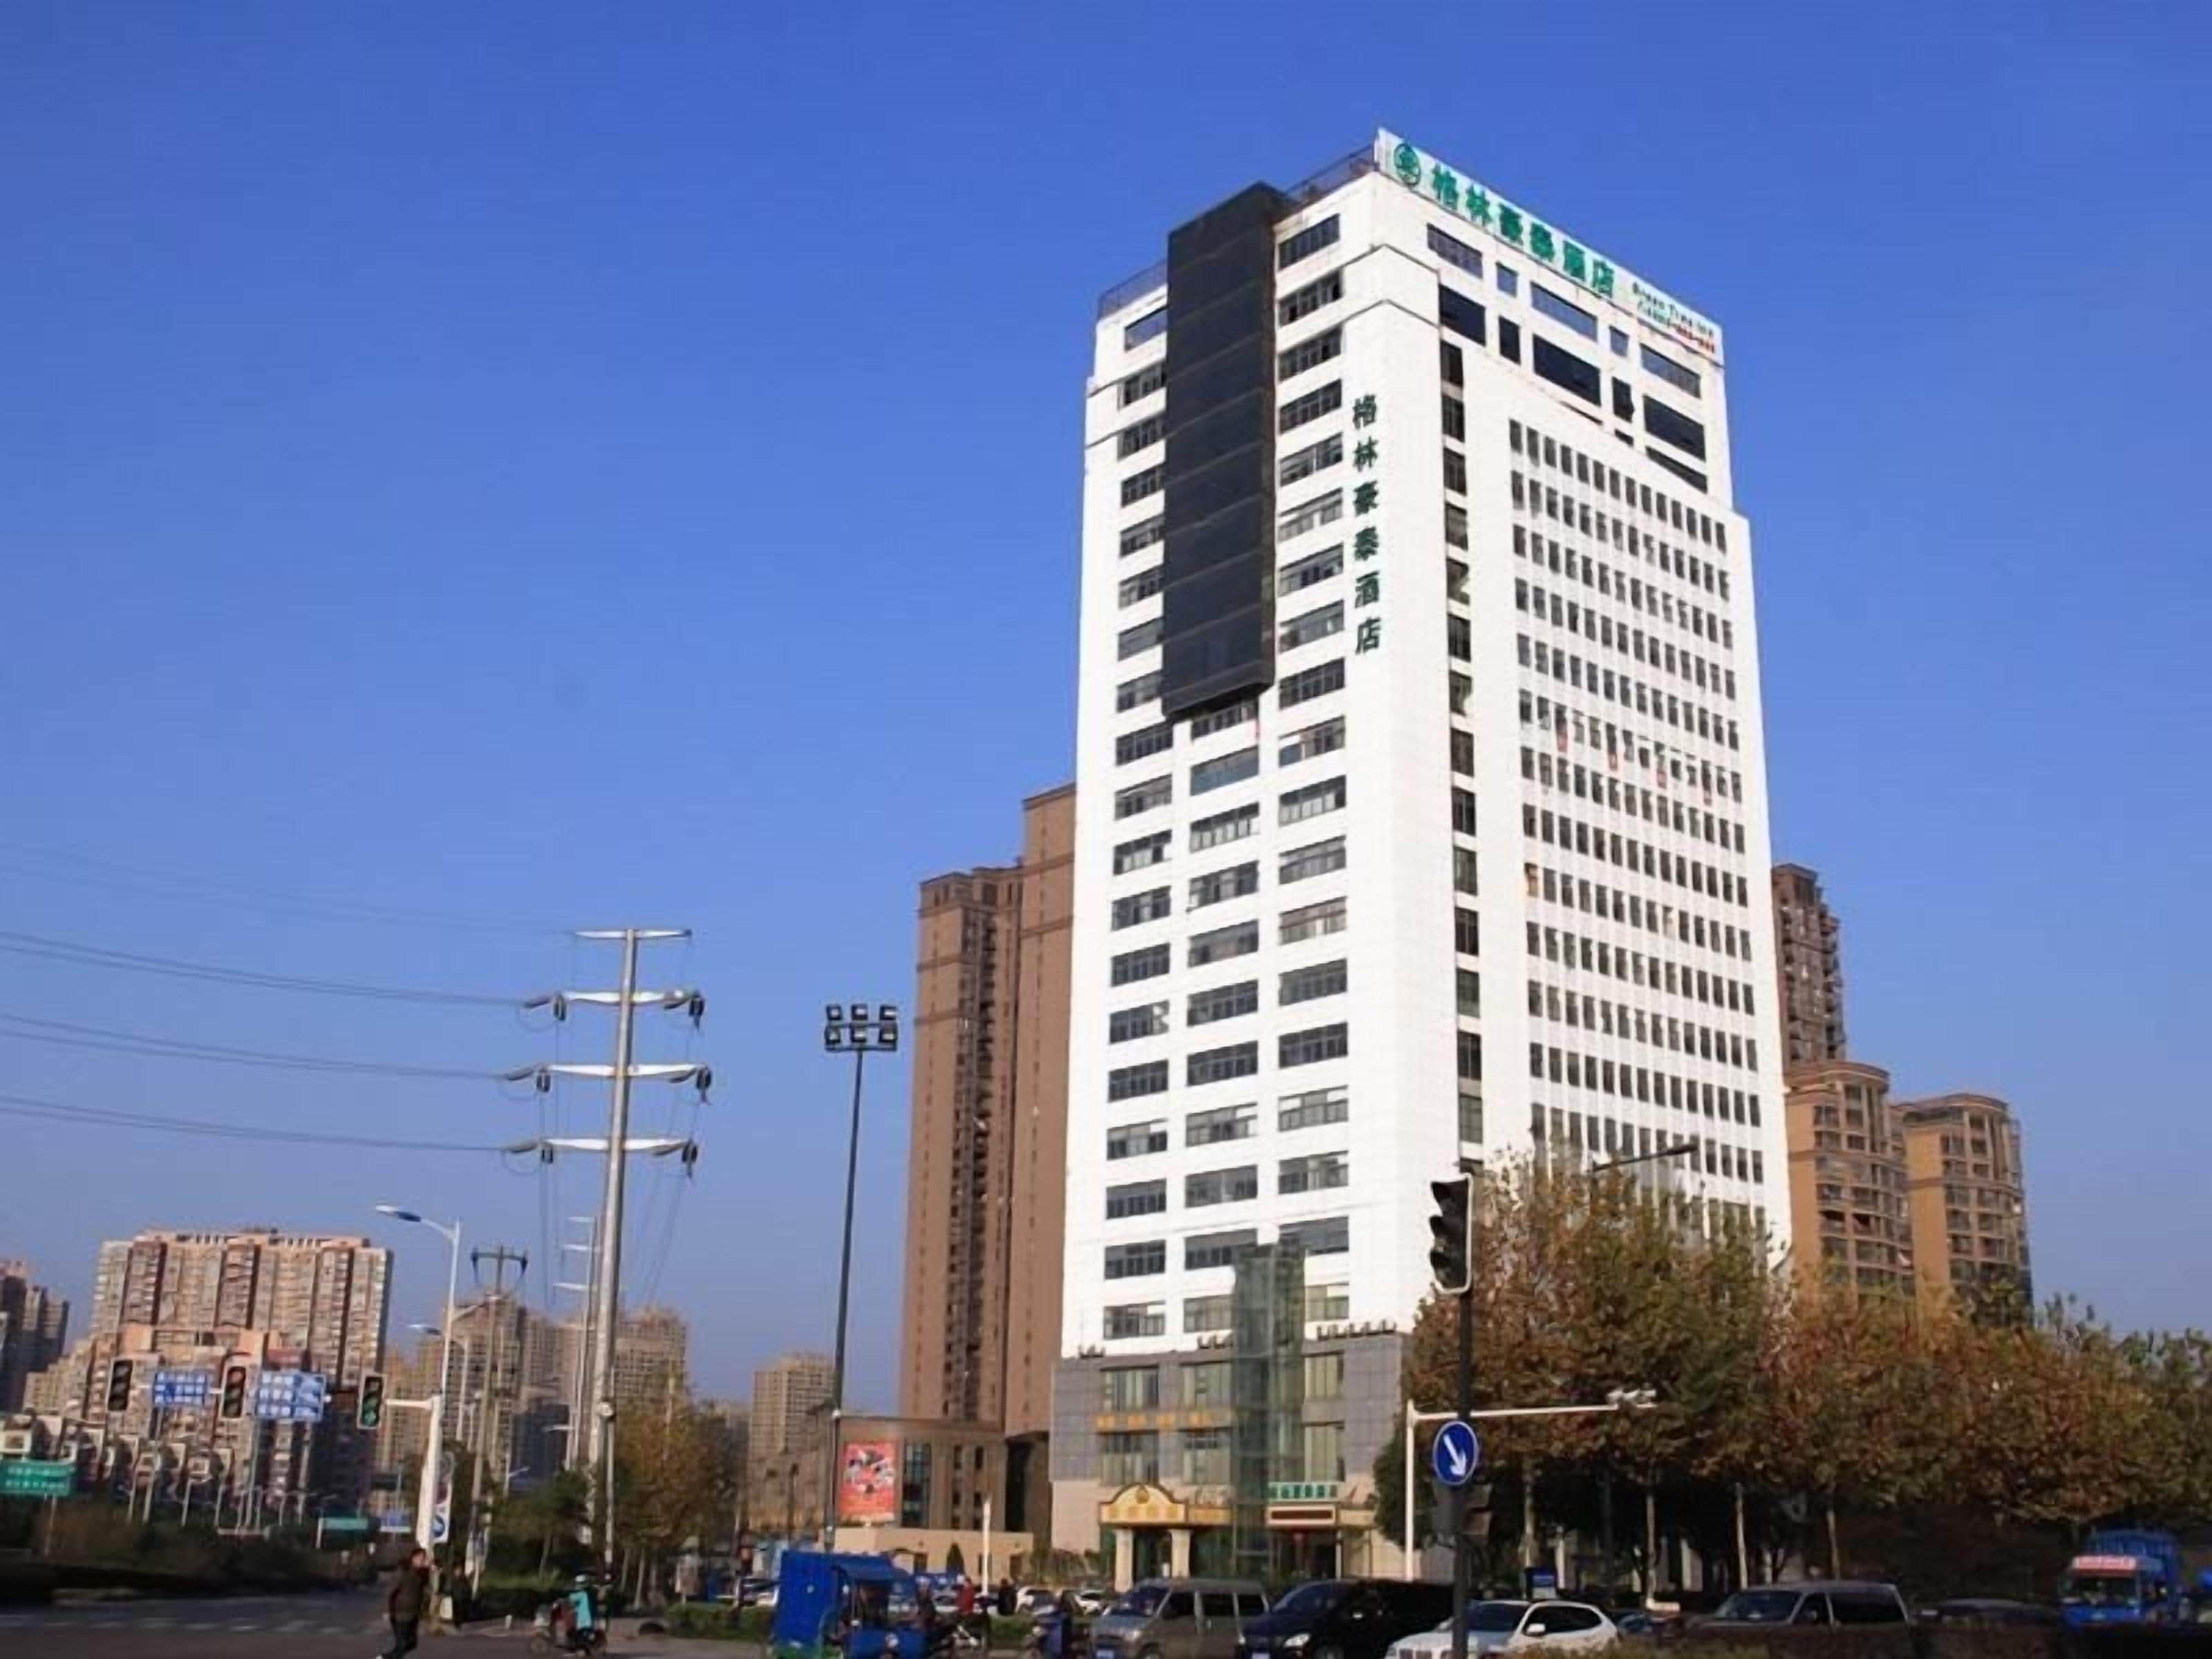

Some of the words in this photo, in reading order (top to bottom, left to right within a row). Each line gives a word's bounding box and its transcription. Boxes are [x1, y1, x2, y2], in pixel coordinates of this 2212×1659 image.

[1352, 394, 1380, 655] 格林豪泰酒店
